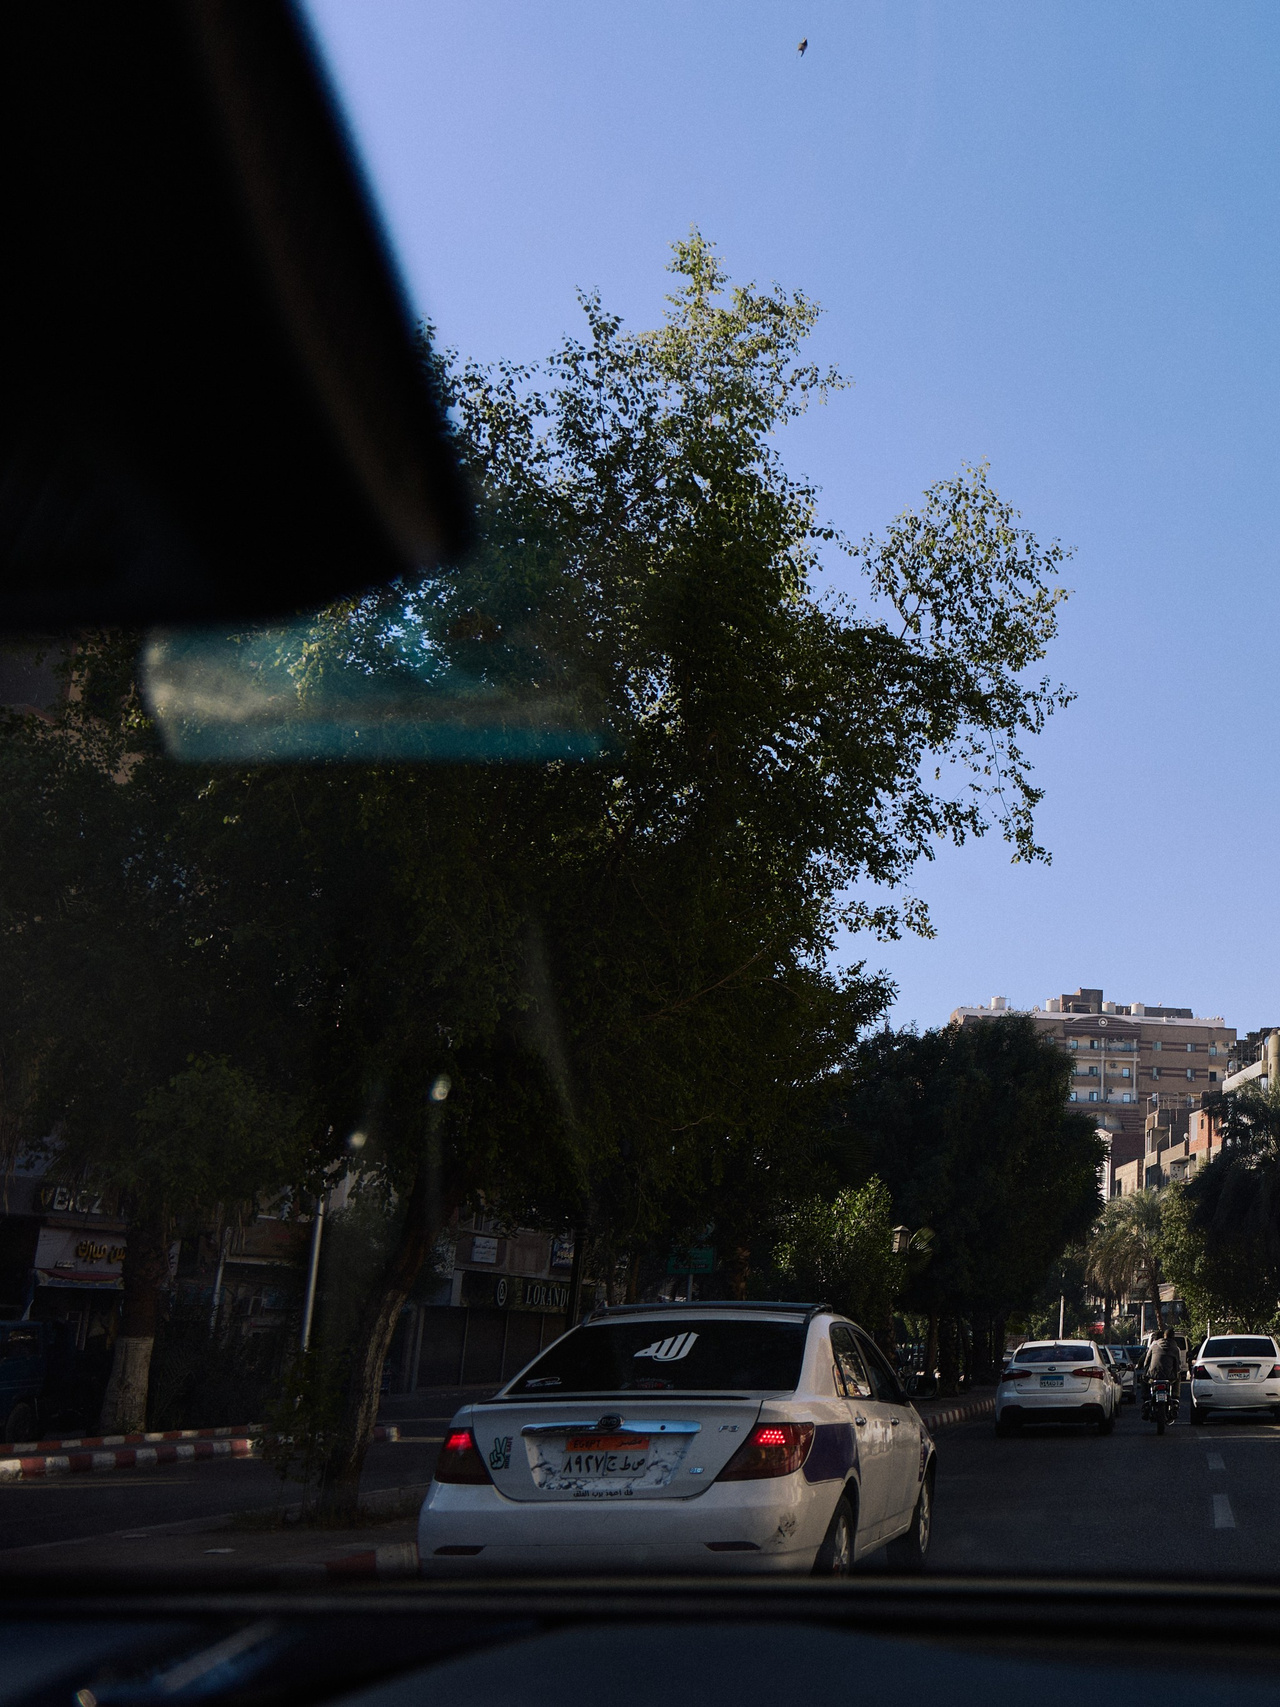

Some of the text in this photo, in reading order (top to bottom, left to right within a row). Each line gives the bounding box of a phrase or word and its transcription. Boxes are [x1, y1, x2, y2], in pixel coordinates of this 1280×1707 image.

[633, 1331, 700, 1362] الله
[718, 1424, 740, 1433] F3
[573, 1439, 601, 1449] EGYPT
[617, 1439, 643, 1448] مصر
